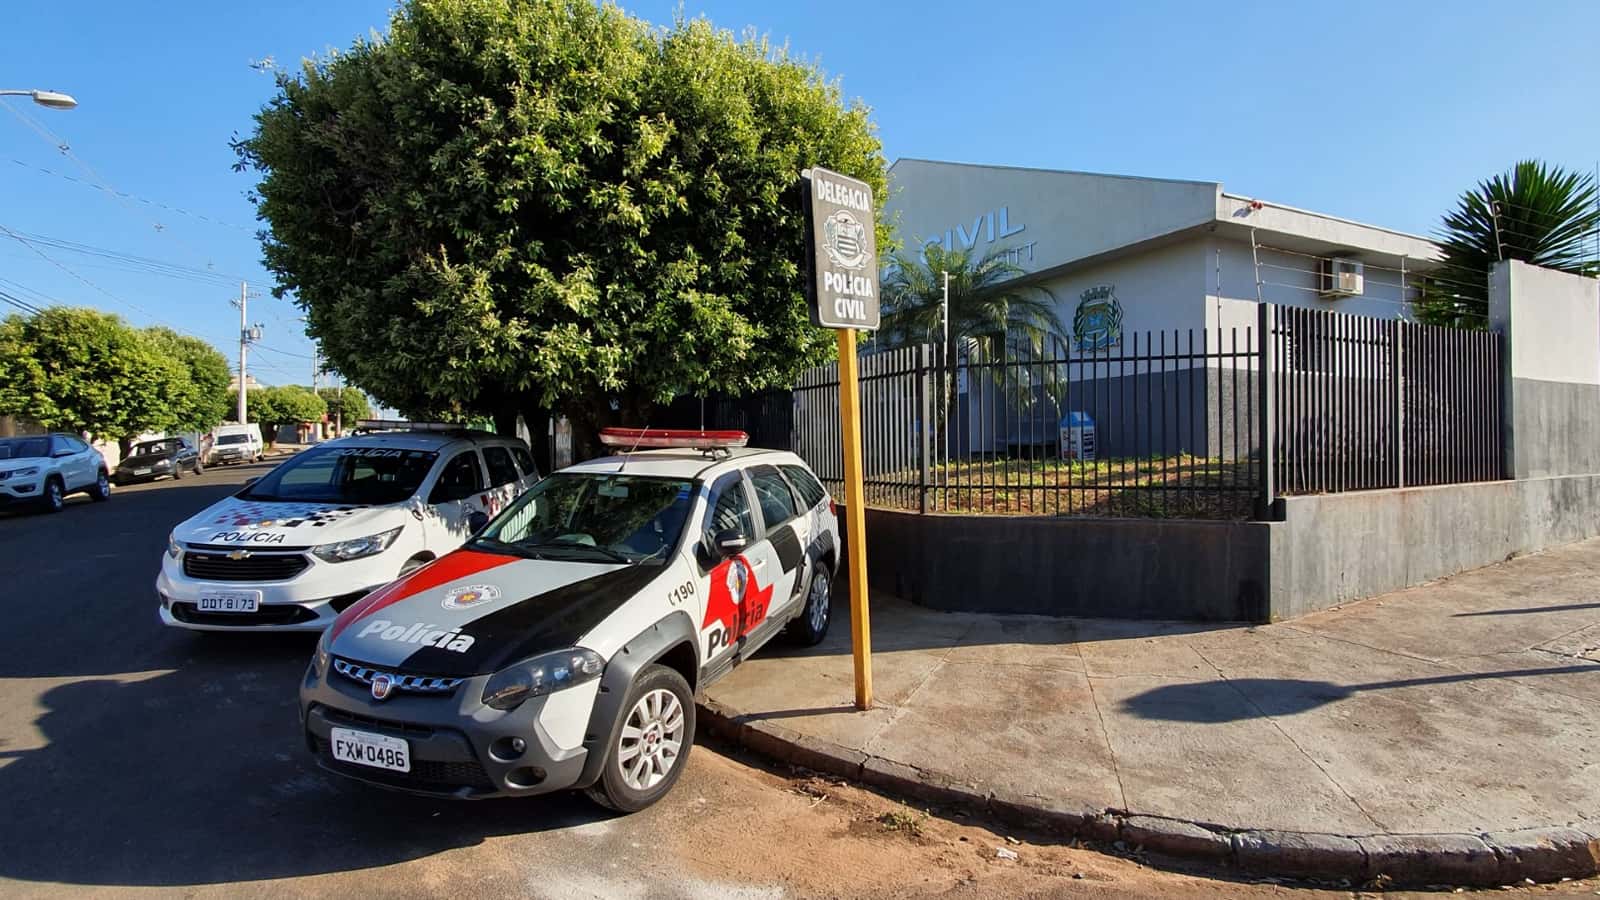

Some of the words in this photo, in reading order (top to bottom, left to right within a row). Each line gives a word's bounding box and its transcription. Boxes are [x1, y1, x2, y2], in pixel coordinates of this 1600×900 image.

[817, 179, 870, 212] DELEGACIA
[824, 271, 874, 297] POLÍCIA
[835, 299, 866, 320] CIVIL
[673, 581, 694, 602] 190
[356, 620, 475, 653] Polícia
